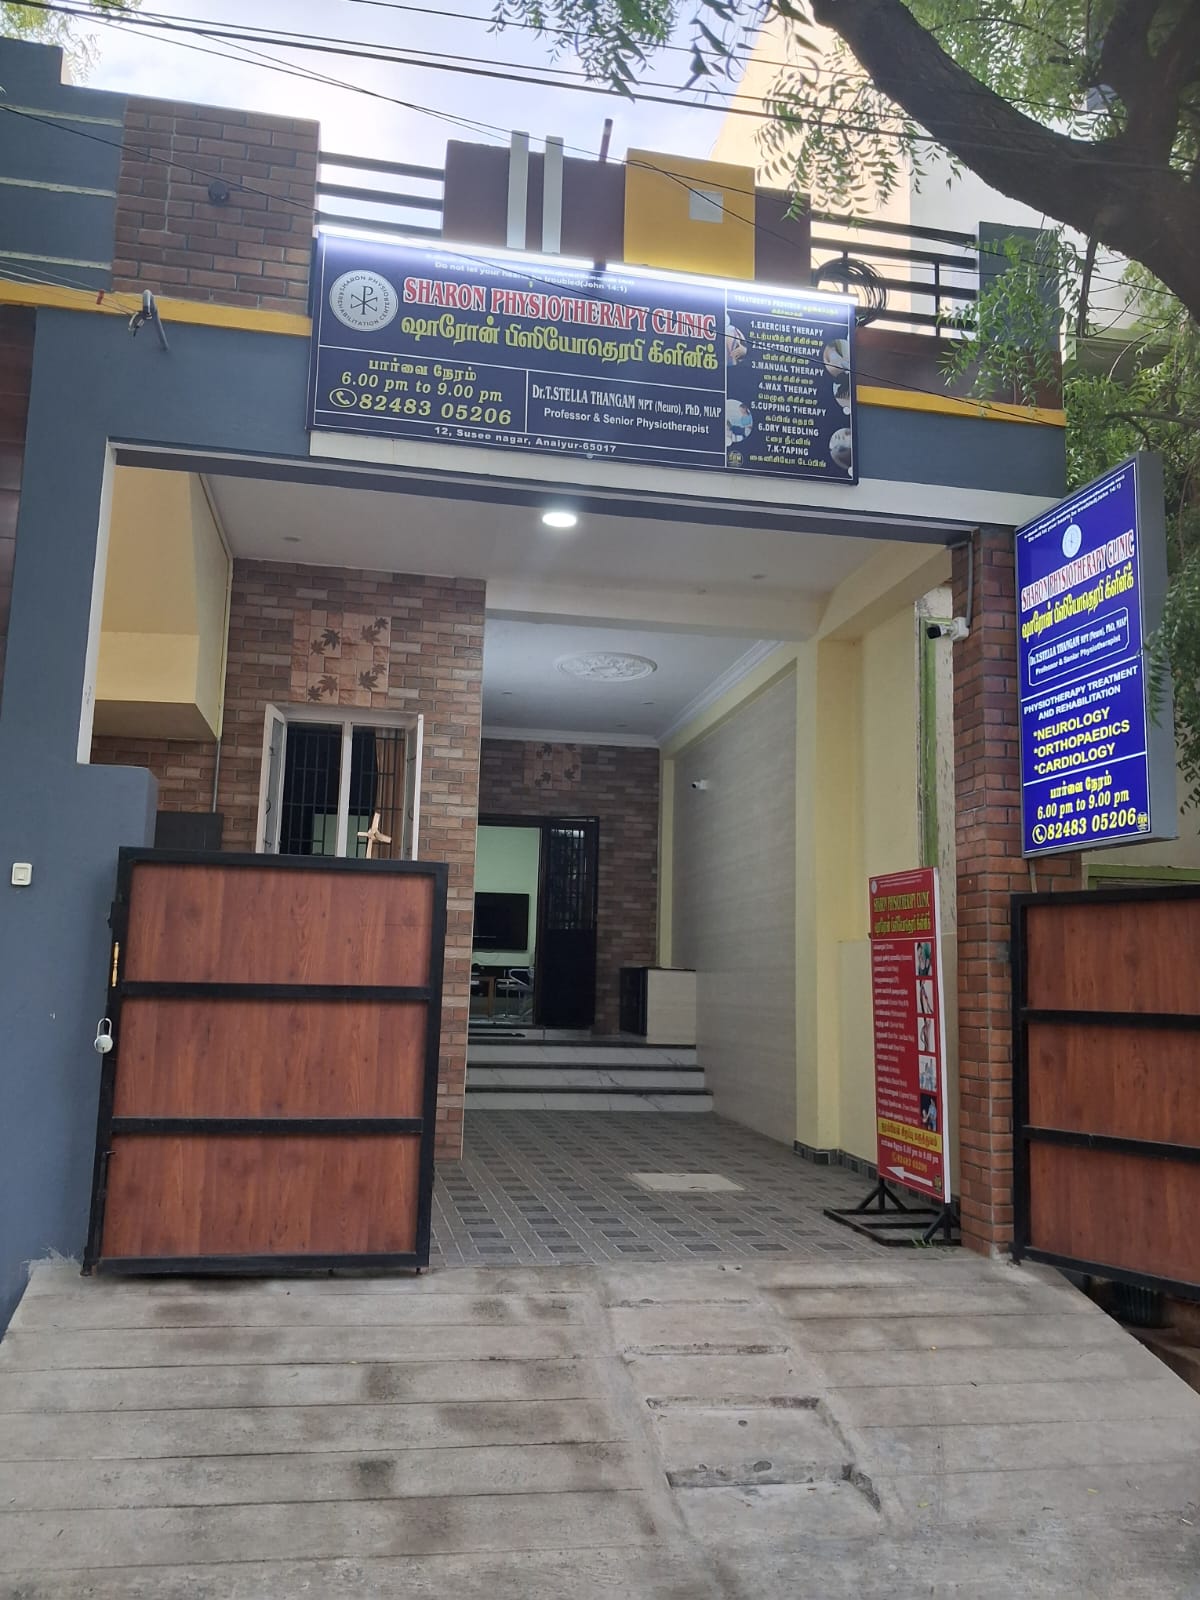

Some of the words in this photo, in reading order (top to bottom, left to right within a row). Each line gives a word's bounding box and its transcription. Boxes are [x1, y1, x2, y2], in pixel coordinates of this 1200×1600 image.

[449, 264, 464, 272] not
[480, 267, 500, 276] your
[403, 276, 487, 312] SHARON
[490, 288, 649, 332] PHYSIOTHERAPY
[652, 308, 716, 341] CLINIC
[401, 313, 500, 347] ஷாரோன்
[505, 323, 646, 365] பிஸியோதெரபி
[648, 339, 719, 370] கிளினிக்
[750, 320, 790, 333] 1.EXERCISE
[792, 325, 823, 337] THERAPY
[369, 357, 428, 376] பார்வை
[433, 365, 476, 383] நேரம்
[751, 361, 788, 372] 3.MANUAL
[791, 365, 824, 377] THERAPY
[341, 371, 379, 388] 6.00
[384, 378, 409, 393] pm
[415, 379, 431, 394] to
[437, 382, 474, 399] 9.00
[478, 389, 503, 404] pm
[532, 384, 589, 404] Dr.T.STELLA
[591, 391, 635, 409] THANGAM
[637, 398, 653, 411] MPT
[703, 406, 722, 419] MIAP
[759, 382, 781, 392] 4.WAX
[784, 384, 817, 396] THERAPY
[359, 393, 432, 416] 82483
[441, 402, 512, 426] 05206
[544, 407, 590, 422] Professor
[593, 412, 600, 422] &
[603, 413, 634, 426] Senior
[636, 417, 709, 434] Physiotherapist
[751, 401, 790, 413] 5.CUPPING
[793, 405, 826, 417] THERAPY
[434, 426, 452, 438] 12,
[456, 428, 491, 440] Susee
[495, 434, 531, 446] nagar,
[758, 423, 780, 433] 6.DRY
[782, 425, 819, 437] NEEDLING
[767, 444, 809, 456] 7.K-TAPING
[1021, 576, 1049, 613] SHARON
[1048, 544, 1107, 599] PHYSIOTHERAPY
[1106, 529, 1135, 568] CLINIC
[1024, 685, 1086, 715] PHYSIOTHERAPY
[1086, 665, 1138, 692] TREATMENT
[1038, 709, 1055, 721] AND
[1056, 684, 1121, 714] REHABILITATION
[1050, 780, 1083, 799] பார்வை
[1085, 769, 1112, 793] நேரம்
[1037, 803, 1057, 820] 6.00
[1059, 802, 1073, 819] pm
[1076, 798, 1086, 811] to
[1089, 791, 1111, 809] 9.00
[1113, 790, 1129, 807] pm
[1047, 817, 1087, 840] 82483
[1092, 807, 1136, 832] 05206
